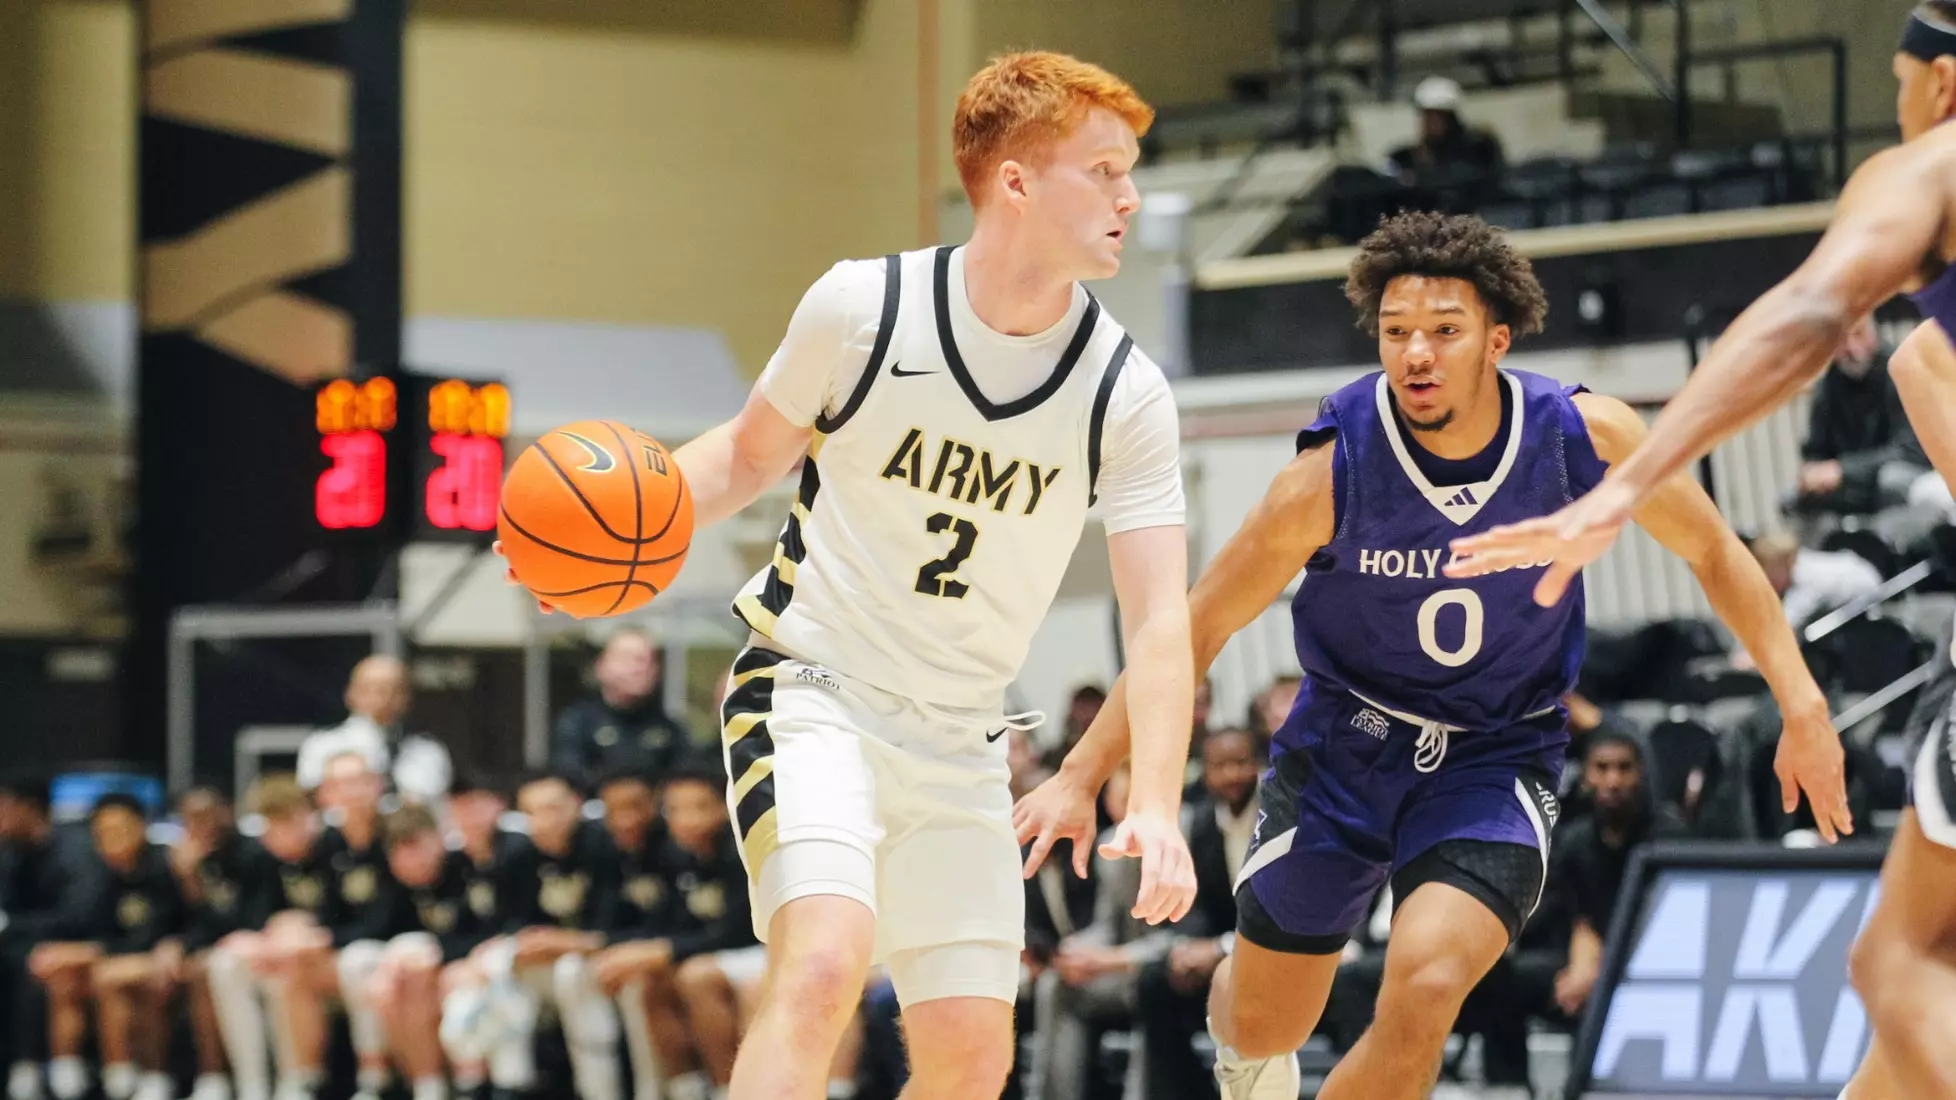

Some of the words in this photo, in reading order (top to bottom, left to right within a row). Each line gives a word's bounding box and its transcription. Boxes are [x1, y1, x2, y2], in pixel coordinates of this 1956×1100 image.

[878, 425, 1064, 516] ARMY
[913, 511, 979, 600] 2
[1359, 548, 1442, 579] HOLY
[1416, 587, 1484, 667] 0
